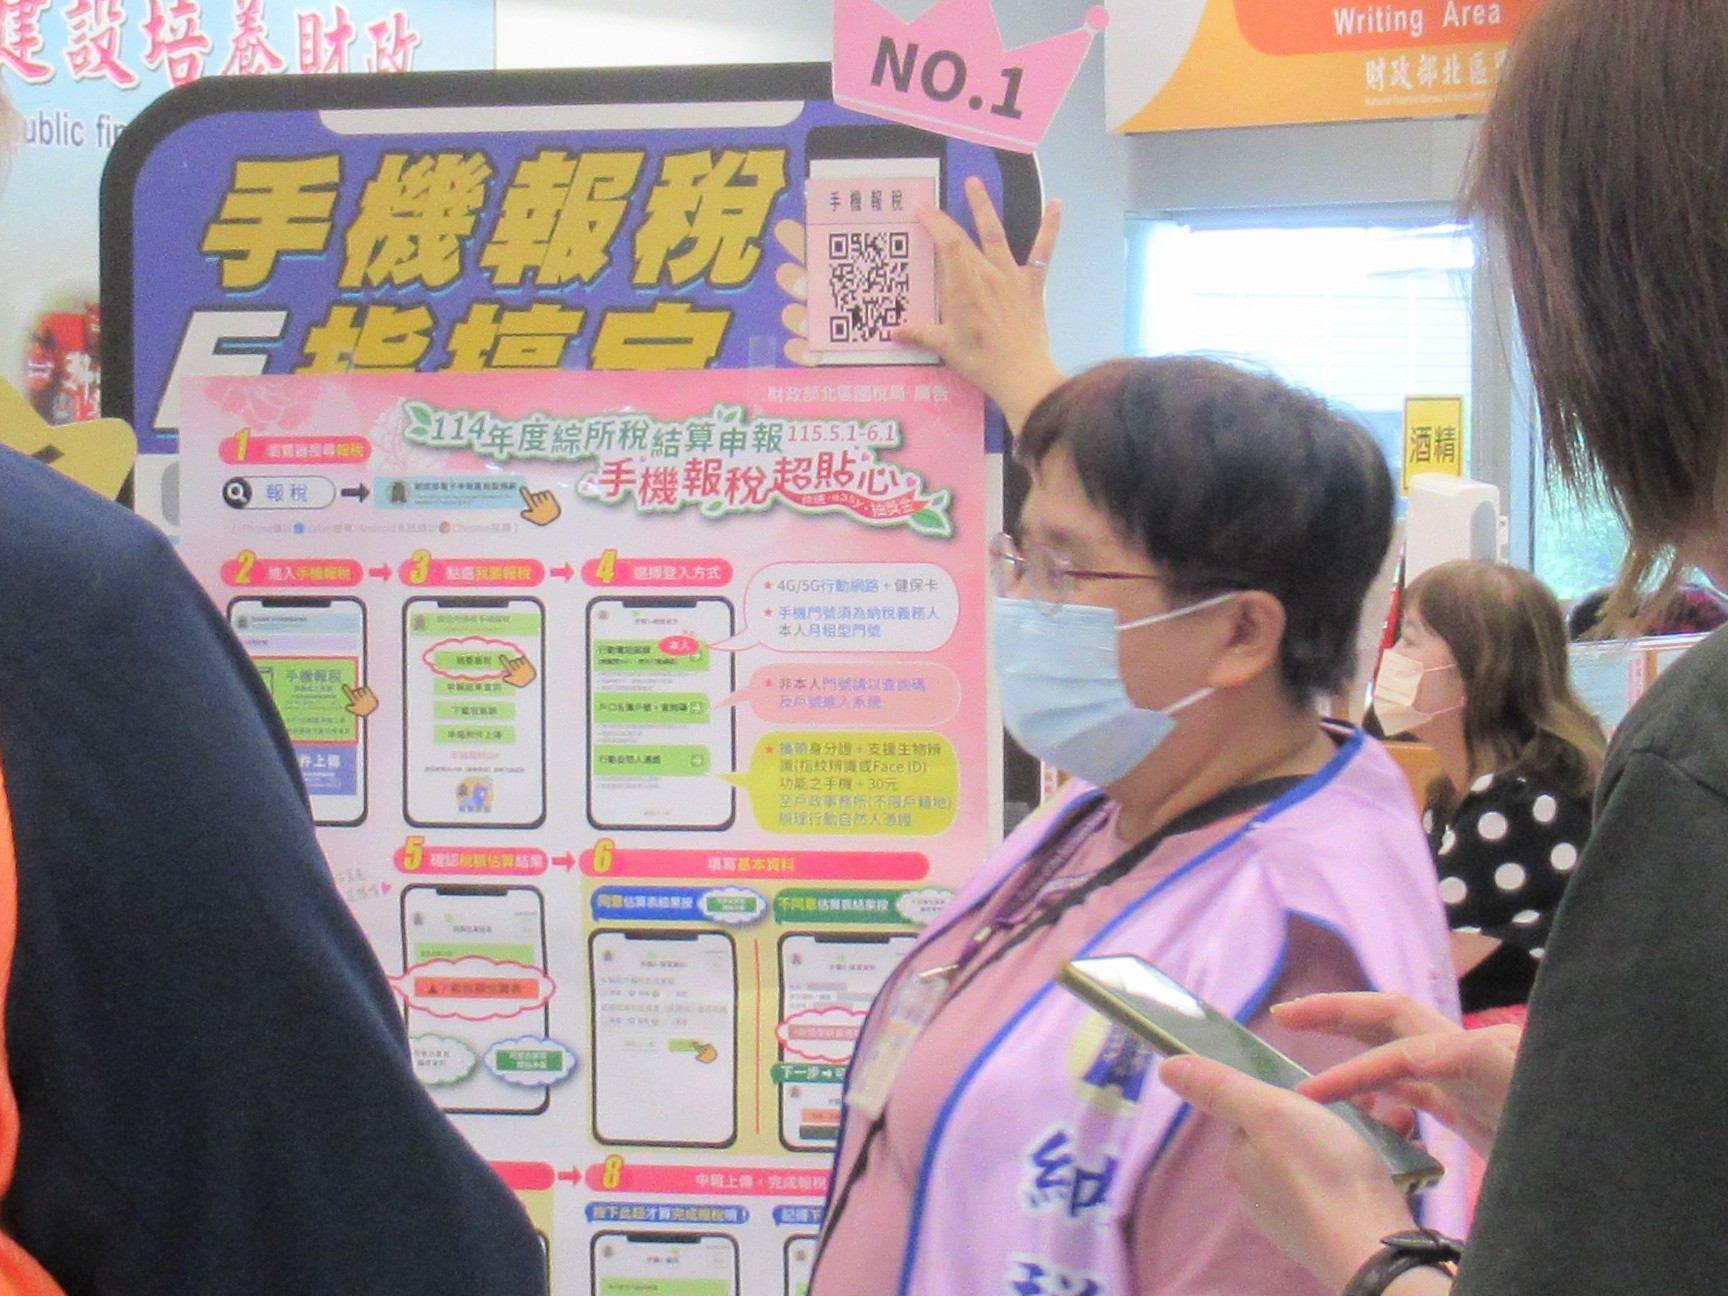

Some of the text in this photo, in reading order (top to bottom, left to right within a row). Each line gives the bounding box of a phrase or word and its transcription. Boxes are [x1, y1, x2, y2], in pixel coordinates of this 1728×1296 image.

[1333, 0, 1502, 37] Writing Area
[871, 35, 1025, 120] NO.1
[22, 110, 85, 147] ublic
[200, 147, 792, 292] 手機報稅
[1409, 426, 1457, 465] 酒精
[598, 450, 900, 506] 手機報稅超貼心
[234, 549, 257, 584] 2
[409, 549, 432, 584] 3
[595, 548, 618, 584] 4
[403, 835, 425, 871] 5
[592, 838, 615, 873] 6
[602, 1153, 624, 1189] 8
